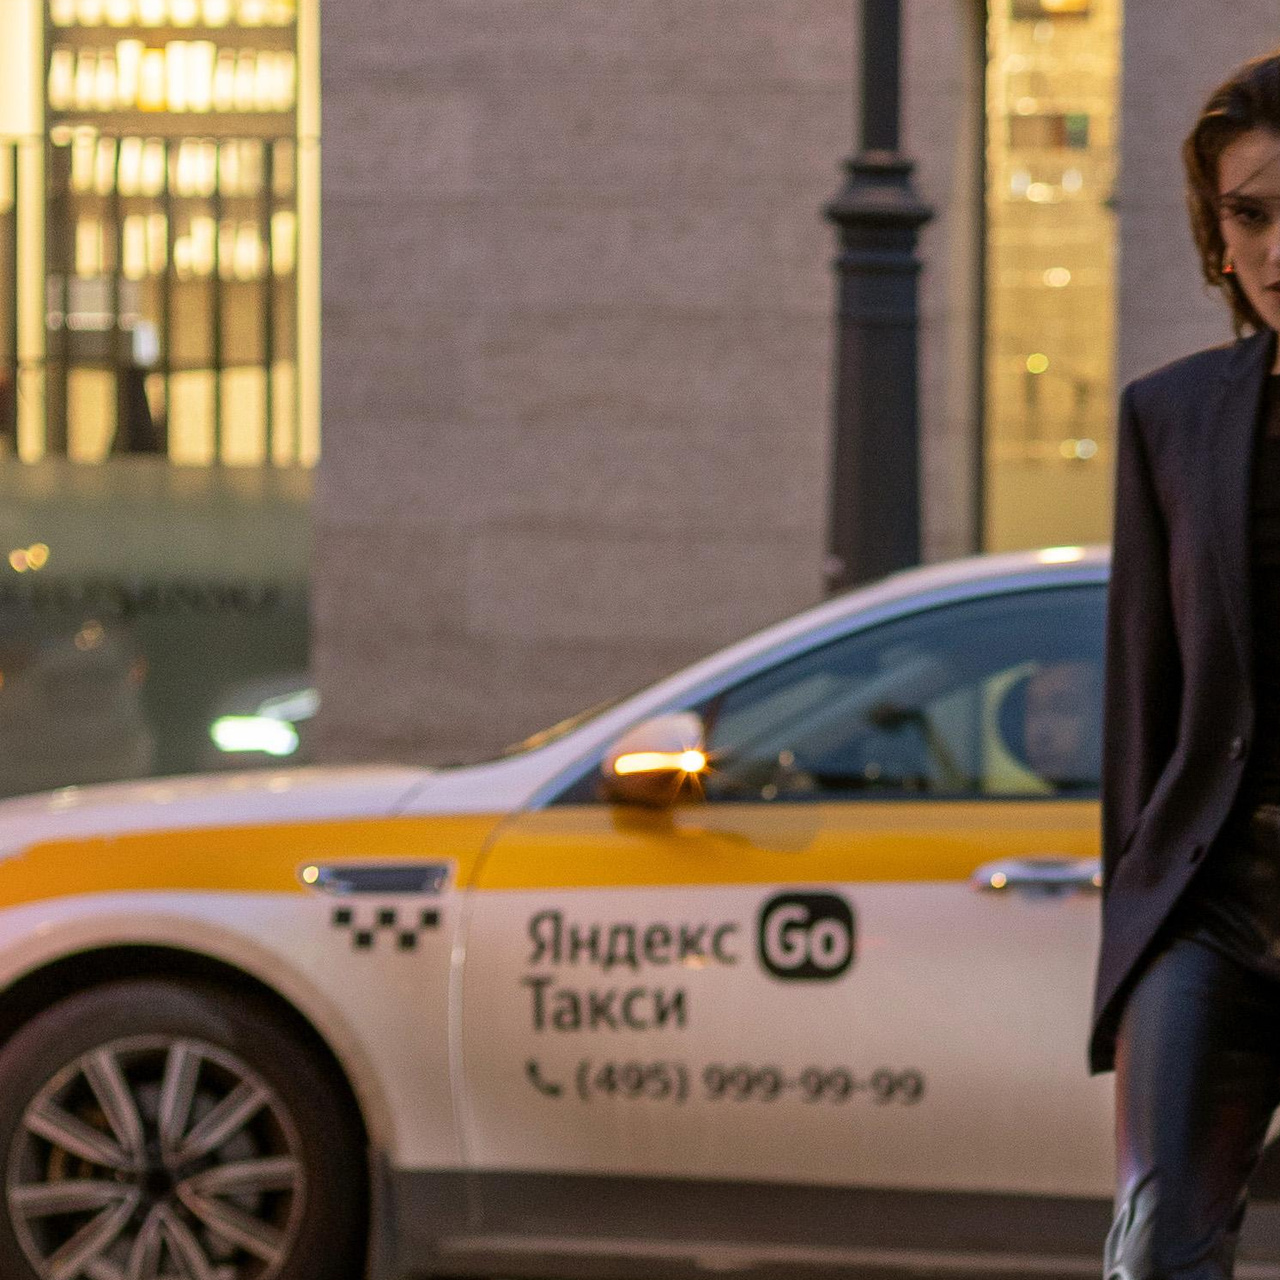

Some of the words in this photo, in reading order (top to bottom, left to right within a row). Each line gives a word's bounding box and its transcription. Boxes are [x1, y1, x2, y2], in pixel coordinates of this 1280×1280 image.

[527, 910, 741, 971] Яндекс
[764, 904, 851, 969] Go
[523, 976, 688, 1032] Такси
[576, 1057, 690, 1105] (495)
[703, 1062, 927, 1105] 999-99-99
